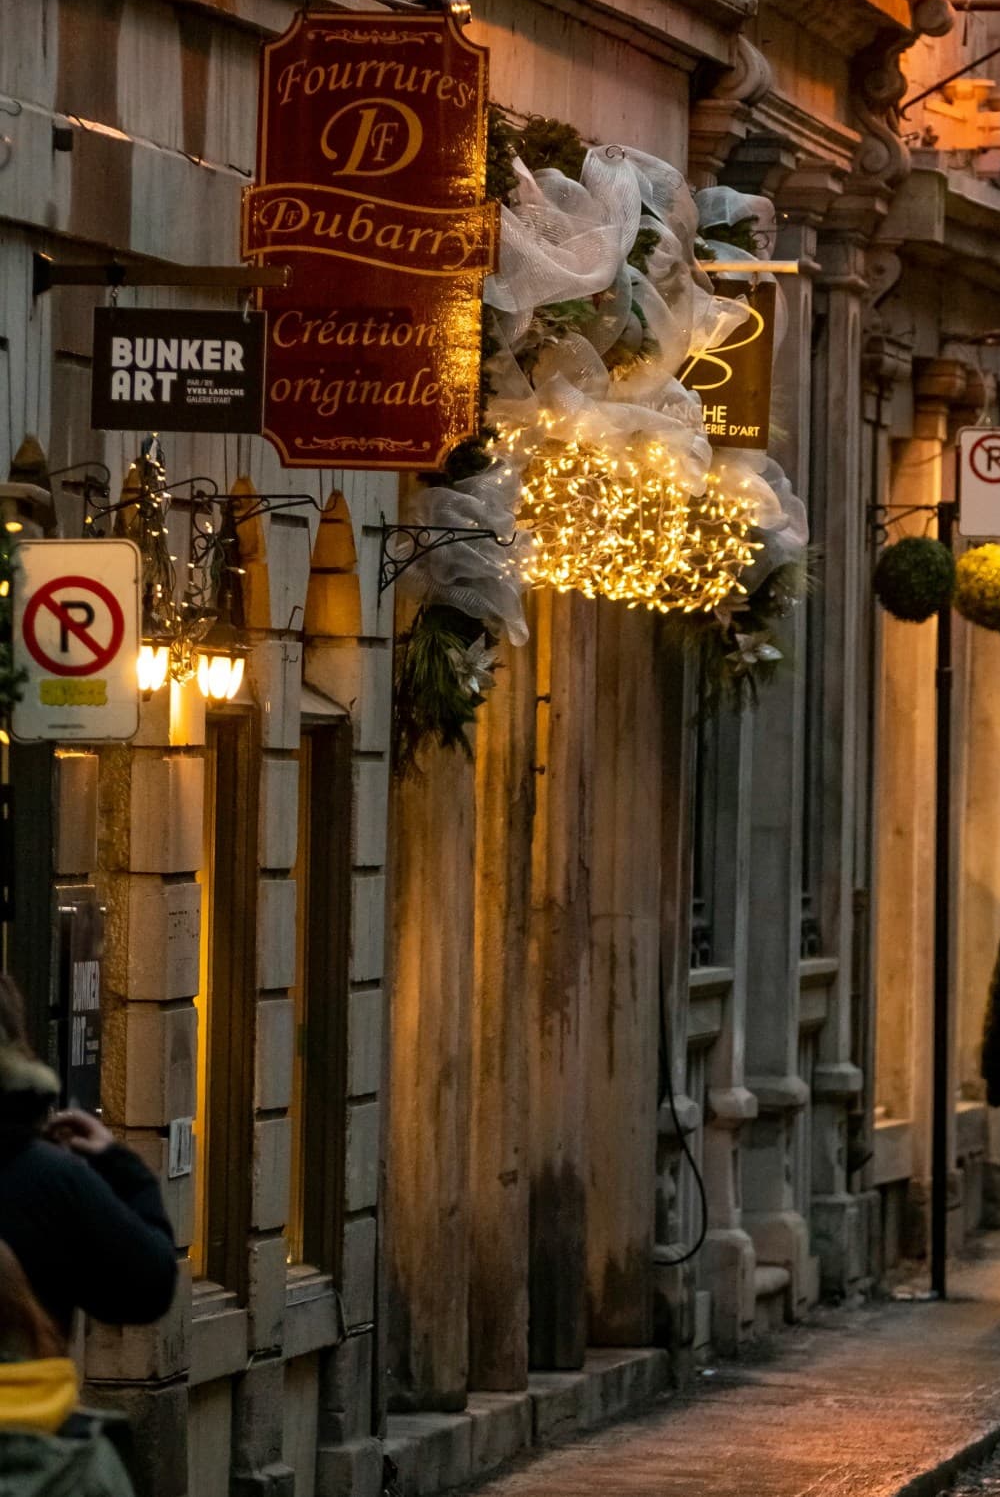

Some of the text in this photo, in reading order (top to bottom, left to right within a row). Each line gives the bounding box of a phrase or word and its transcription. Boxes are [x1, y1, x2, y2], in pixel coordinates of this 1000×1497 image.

[277, 59, 477, 108] Fourrures
[259, 197, 480, 271] Dubarry
[112, 337, 245, 371] BUNKER
[111, 370, 178, 402] ART
[187, 387, 207, 395] YVES
[270, 367, 455, 417] originales
[729, 425, 760, 437] D'ART
